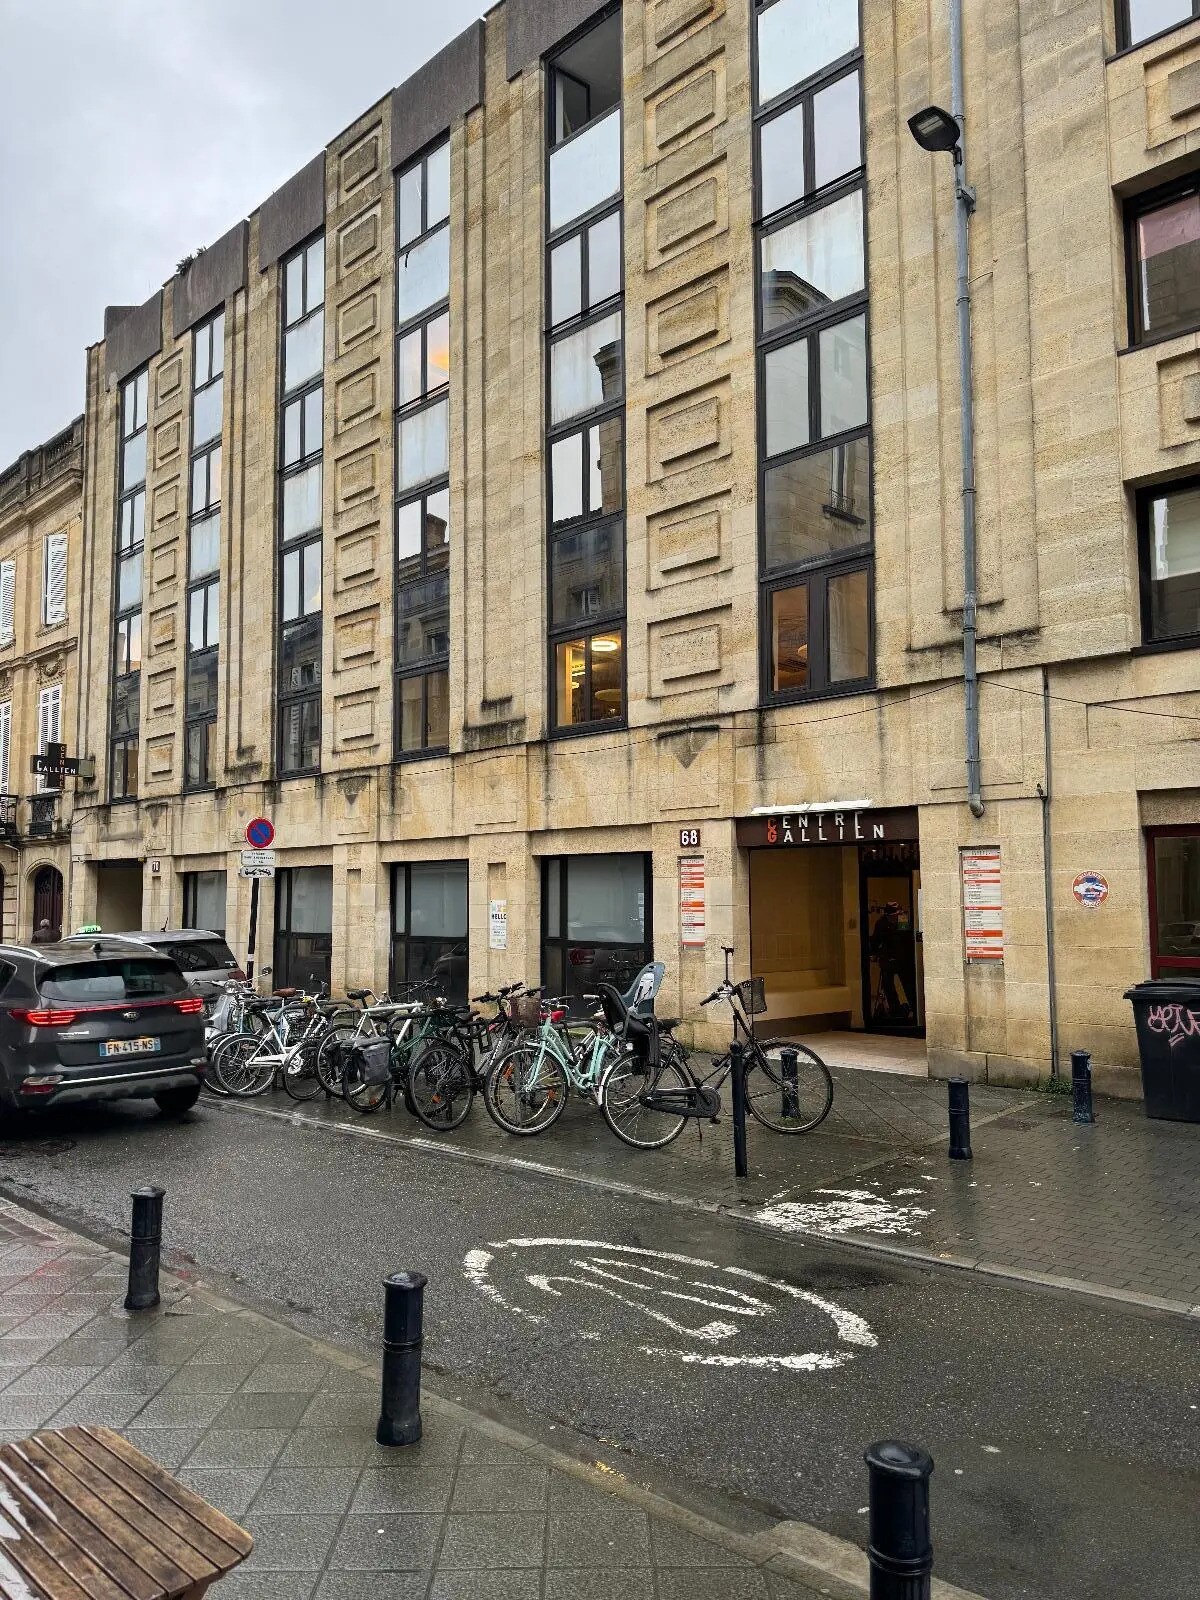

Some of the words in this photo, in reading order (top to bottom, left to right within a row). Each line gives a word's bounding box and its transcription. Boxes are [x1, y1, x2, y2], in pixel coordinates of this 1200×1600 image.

[37, 760, 76, 774] GALLIEN
[767, 811, 865, 839] CENTRE
[681, 830, 698, 845] 68
[767, 824, 886, 843] GALLIEN
[107, 1039, 154, 1055] FN-415-NS
